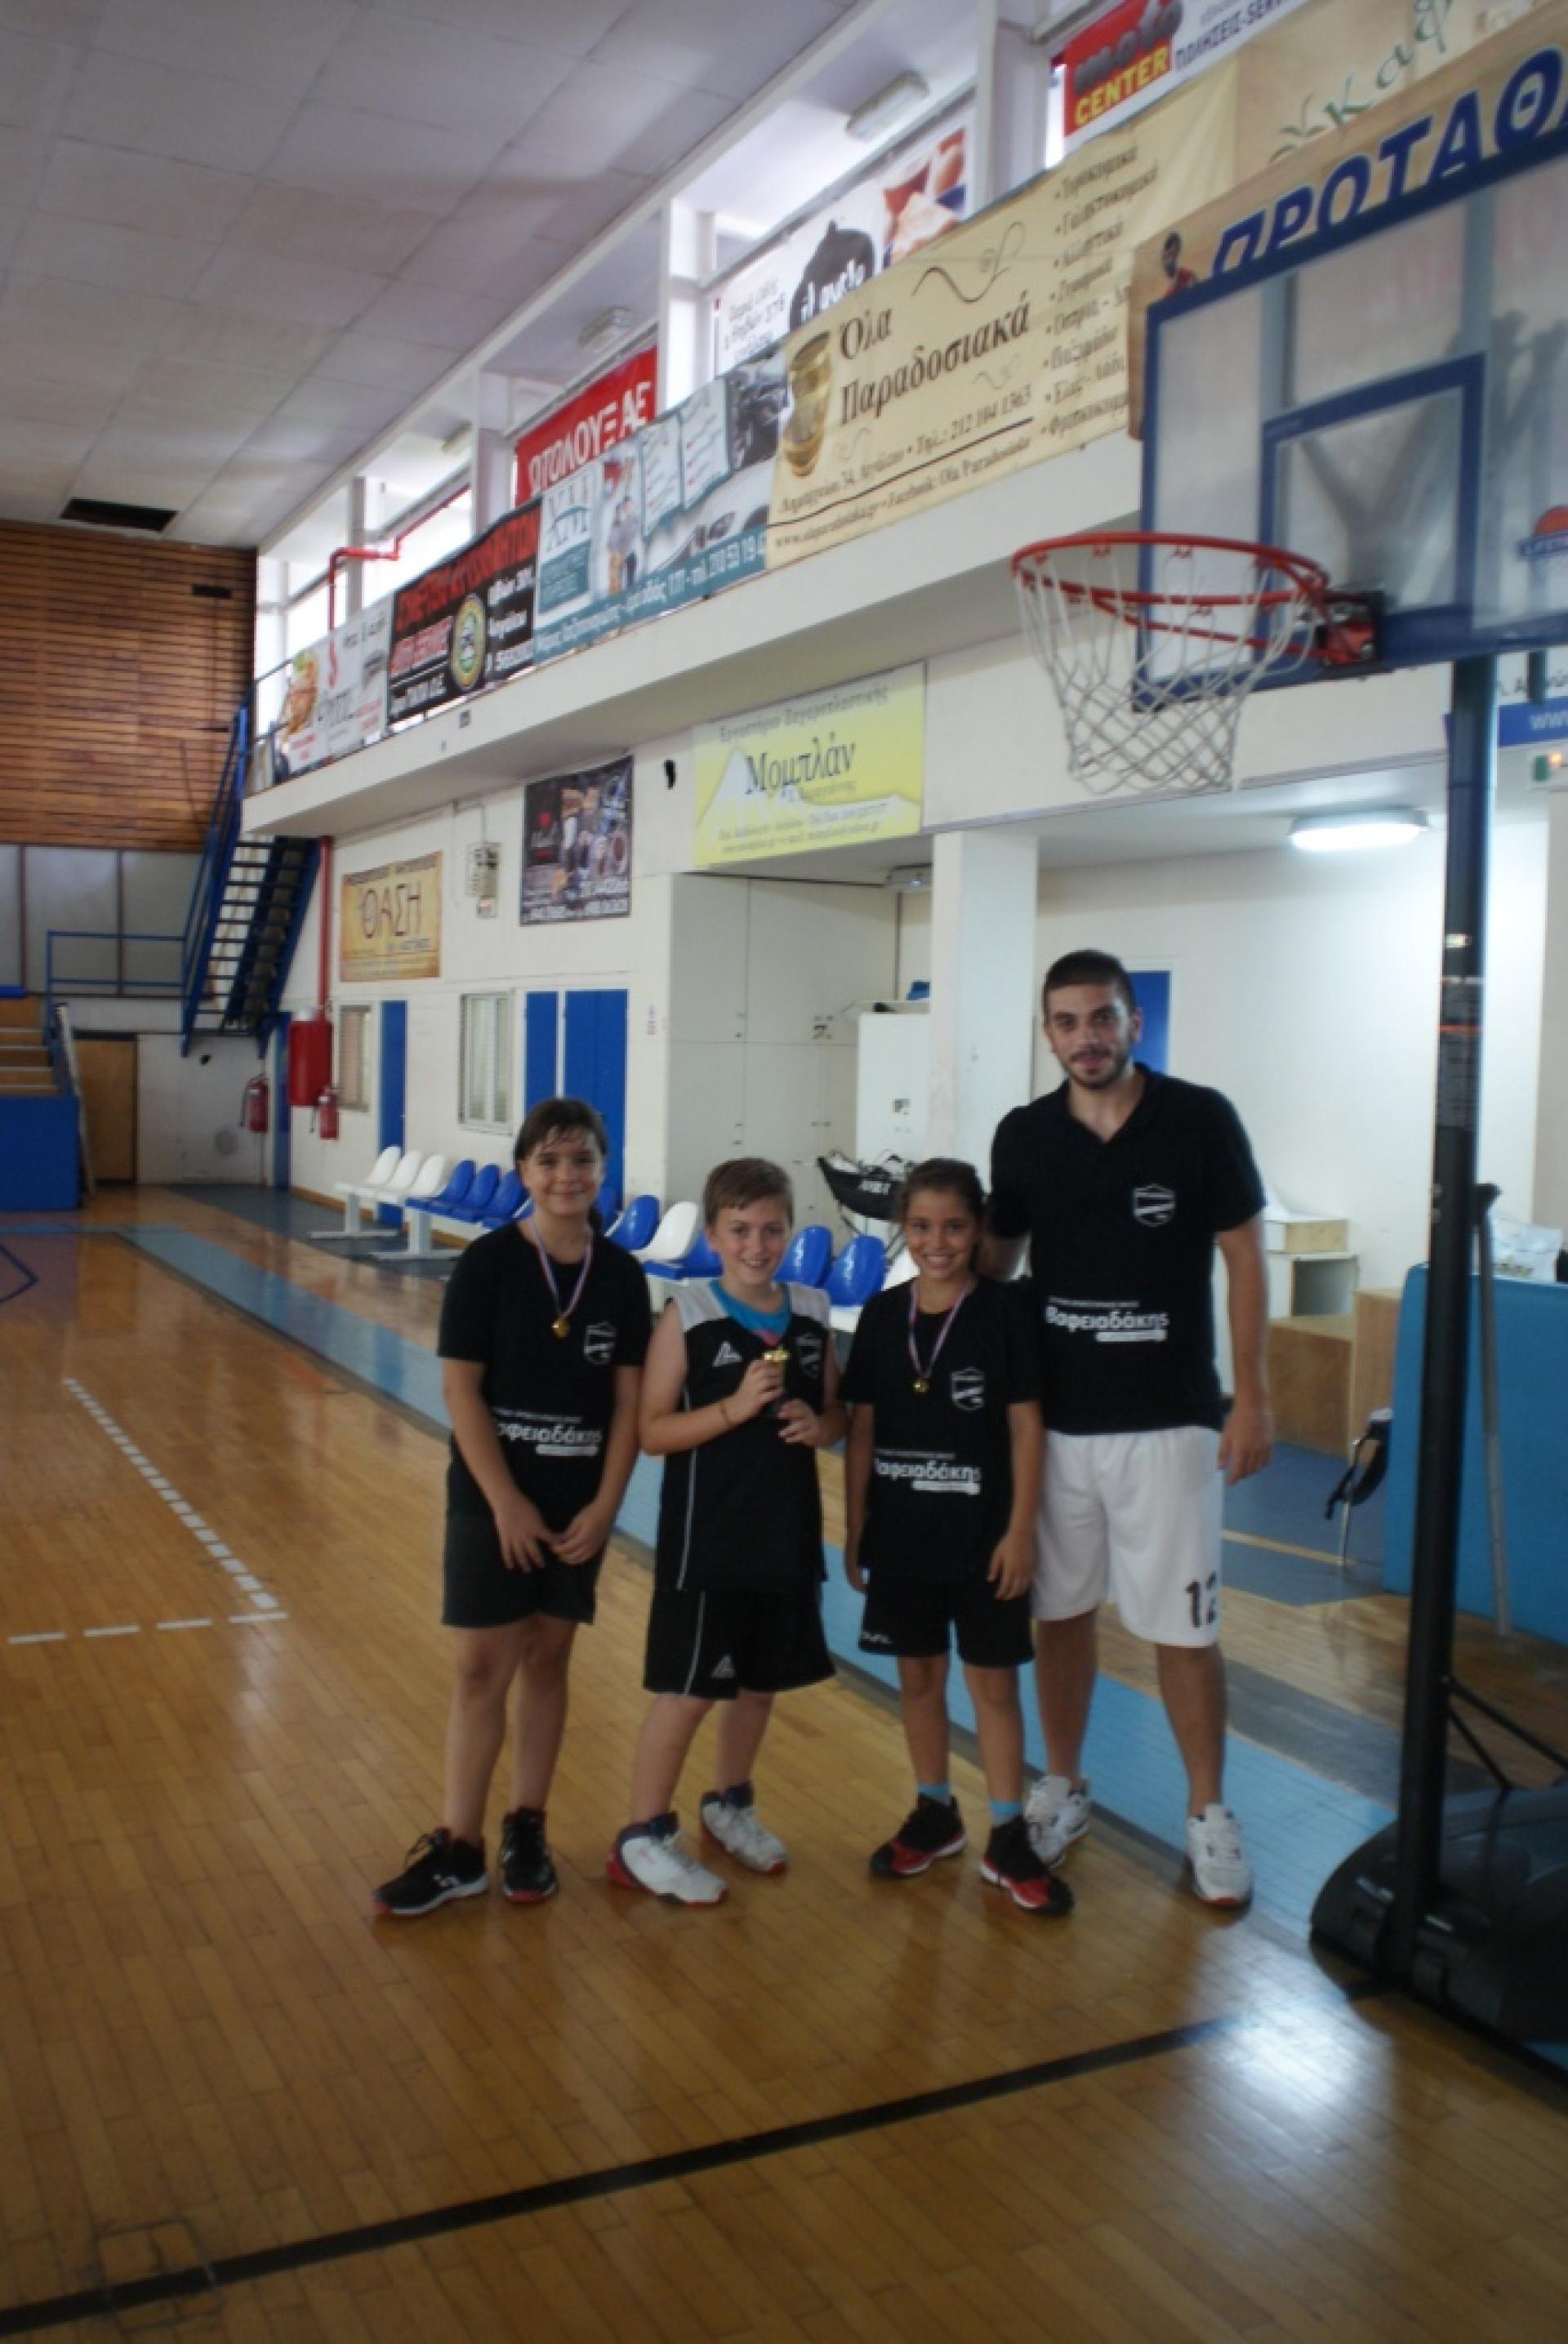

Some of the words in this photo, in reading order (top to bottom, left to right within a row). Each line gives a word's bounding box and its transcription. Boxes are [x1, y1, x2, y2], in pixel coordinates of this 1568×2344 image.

[1074, 46, 1169, 126] CENTER
[840, 288, 1031, 426] Παραδοσιακά
[745, 730, 857, 799] Μομπλάν
